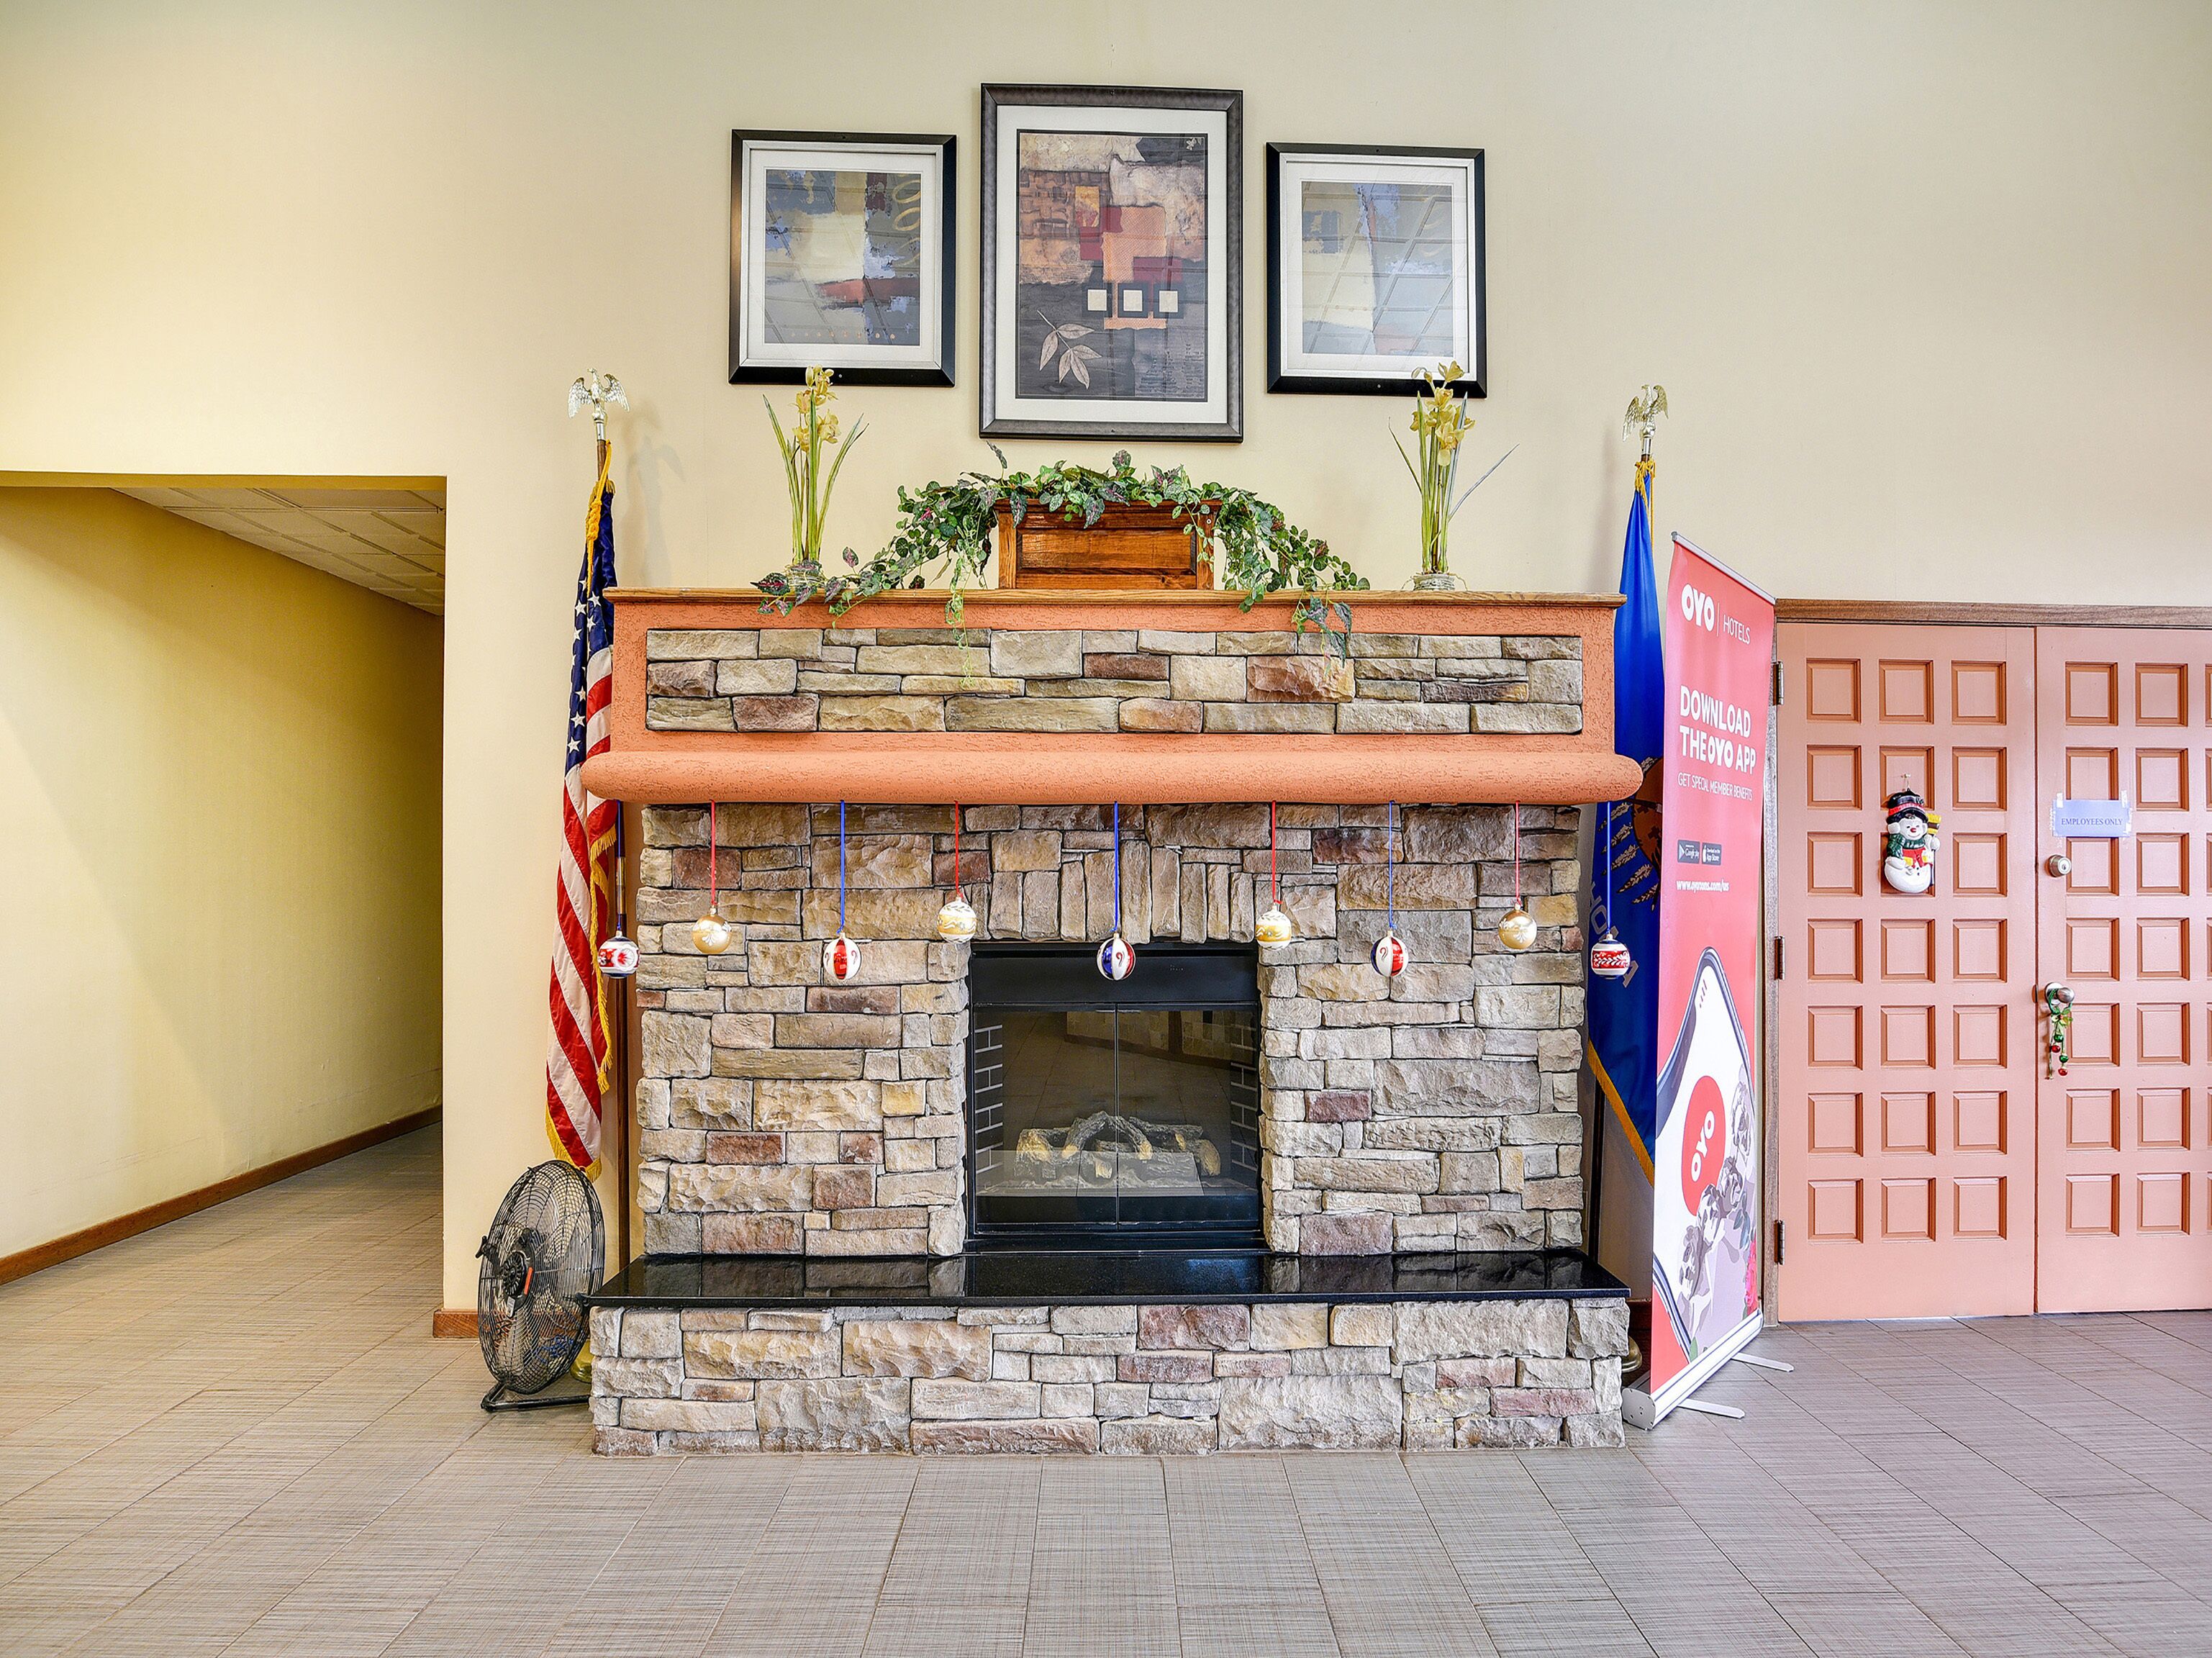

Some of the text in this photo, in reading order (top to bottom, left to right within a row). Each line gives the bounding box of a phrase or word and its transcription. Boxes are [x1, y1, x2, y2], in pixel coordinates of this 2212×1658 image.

[1681, 584, 1751, 645] OYO HOTELS
[1680, 685, 1751, 738] DOWNLOAD
[1679, 725, 1757, 775] THE OYO APP
[1677, 772, 1753, 801] GET SPECIAL MEMBER BENEFITS
[1690, 1110, 1715, 1182] OYO
